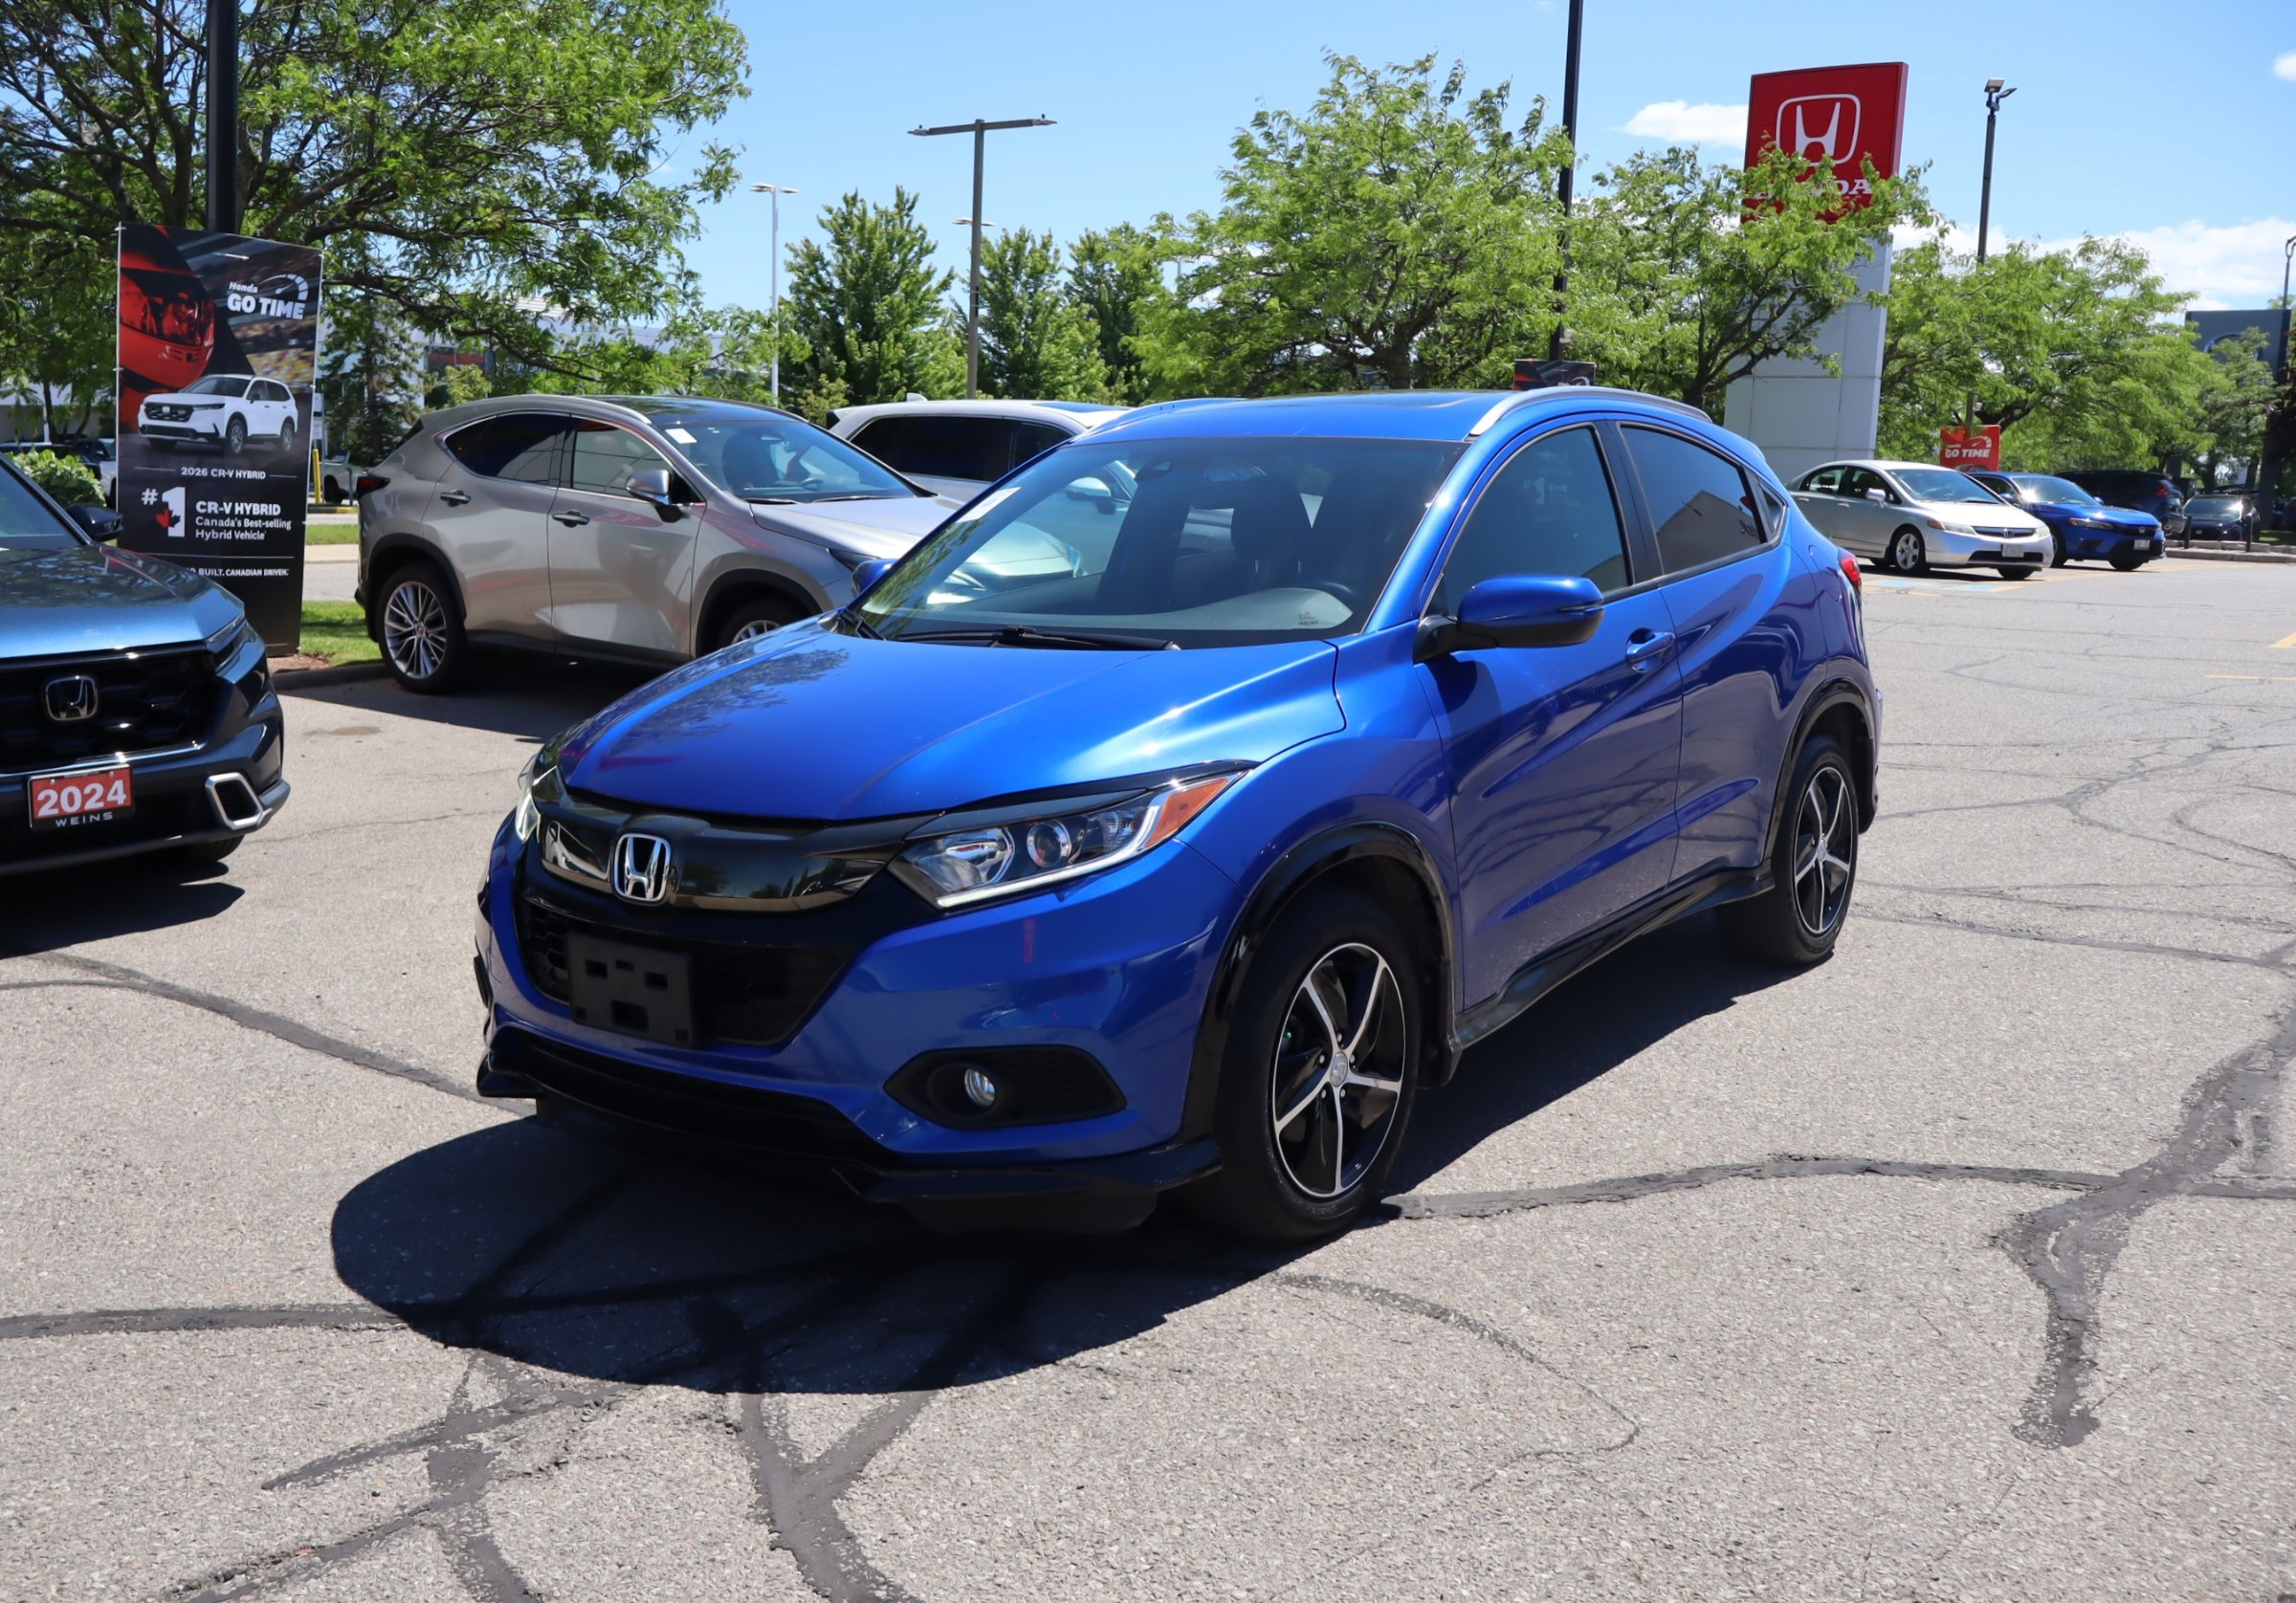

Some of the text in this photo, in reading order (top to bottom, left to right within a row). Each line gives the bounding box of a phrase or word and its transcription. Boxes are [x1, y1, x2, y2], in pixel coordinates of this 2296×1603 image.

[229, 281, 258, 294] Honda
[227, 293, 305, 320] GO TIME
[1945, 449, 1990, 458] GO TIME
[181, 467, 267, 480] 2026 CR-V HYBRID
[195, 501, 281, 516] CR-V HYBRID
[195, 516, 292, 531] Canada's Best-selling
[195, 529, 232, 540] Hybrid
[226, 568, 262, 577] CANADIAN
[36, 780, 127, 818] 2024
[55, 811, 113, 827] WEINS
